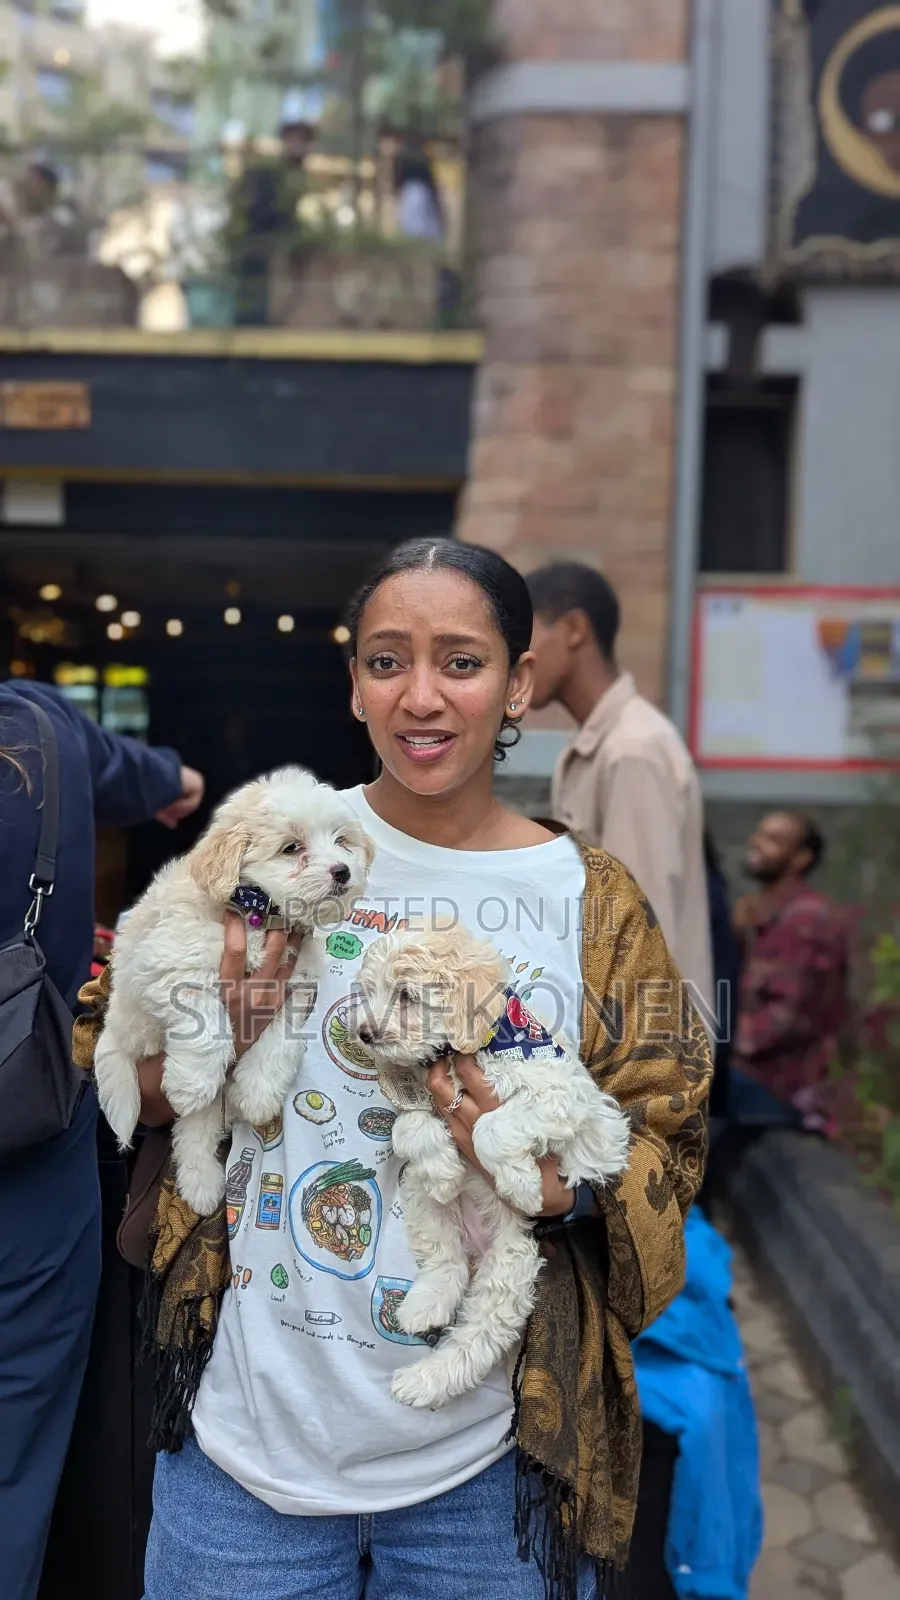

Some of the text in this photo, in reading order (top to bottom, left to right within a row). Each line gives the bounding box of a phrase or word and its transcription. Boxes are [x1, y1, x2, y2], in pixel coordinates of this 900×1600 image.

[335, 935, 355, 946] Mai
[280, 1319, 304, 1332] Designed
[316, 1332, 334, 1340] made
